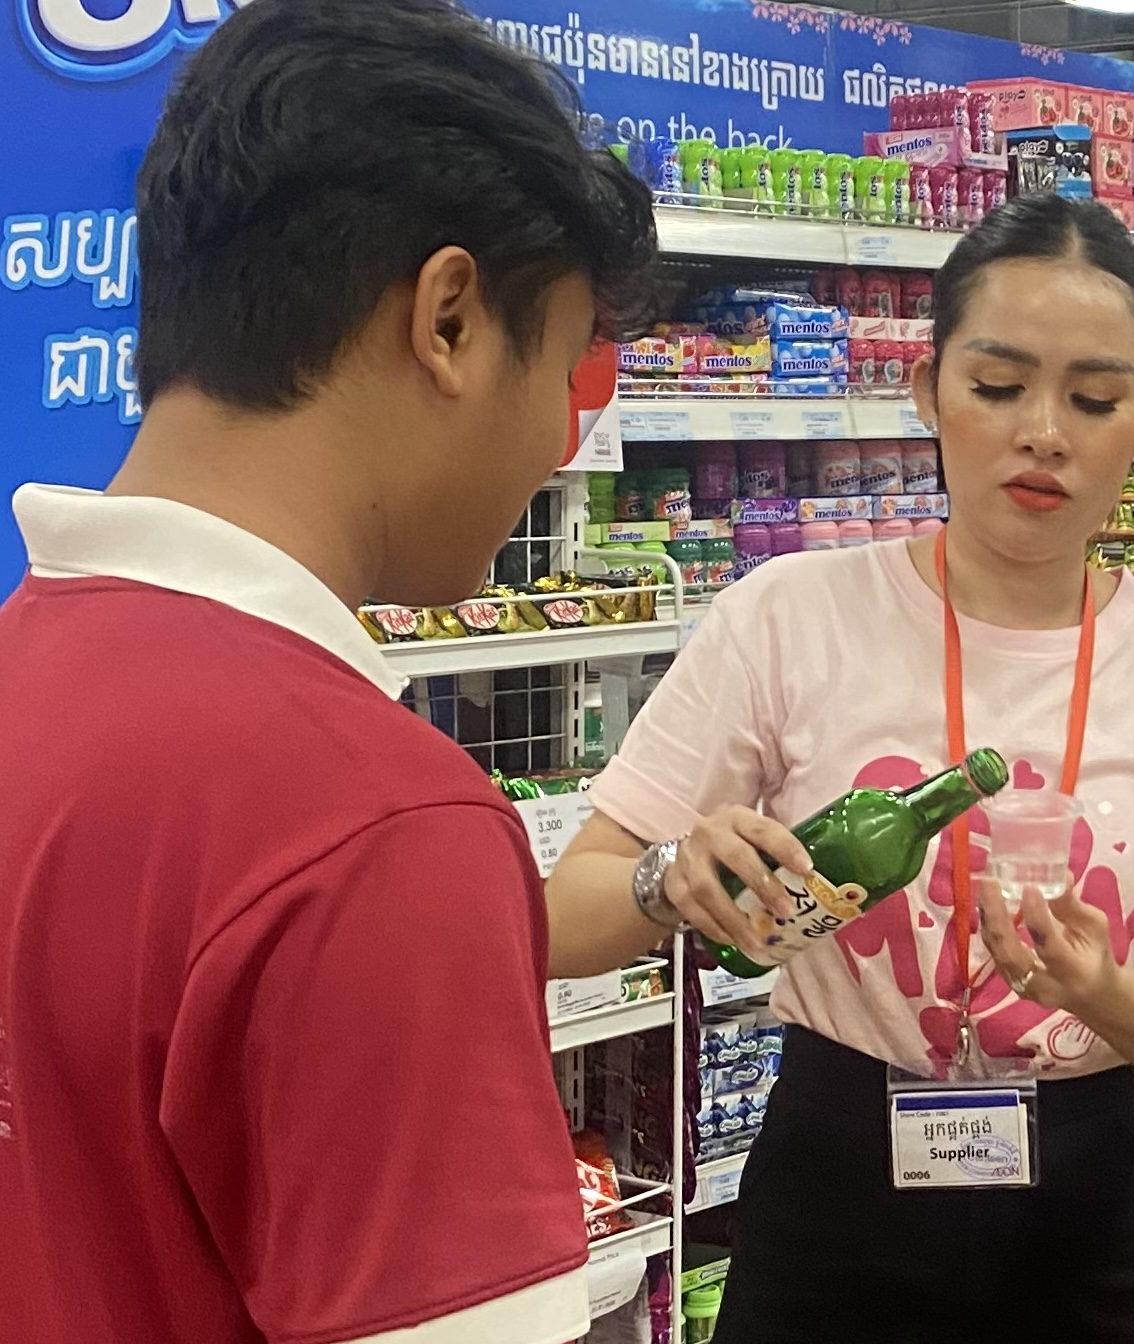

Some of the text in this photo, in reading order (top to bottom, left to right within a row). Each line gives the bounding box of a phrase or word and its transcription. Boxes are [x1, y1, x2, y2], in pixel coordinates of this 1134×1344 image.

[617, 115, 656, 144] on
[668, 112, 717, 141] the
[728, 119, 793, 150] back
[886, 136, 933, 156] mentos
[781, 322, 831, 335] mentos
[622, 351, 675, 367] mentos
[706, 354, 752, 368] mentos
[782, 357, 830, 371] mentos
[861, 469, 896, 486] entos
[744, 510, 782, 522] mentos
[815, 508, 853, 519] mentos
[895, 505, 932, 516] mentos
[608, 530, 644, 542] mentos
[676, 528, 708, 539] mentos
[929, 1145, 990, 1162] Supplier
[903, 1170, 931, 1181] 0006
